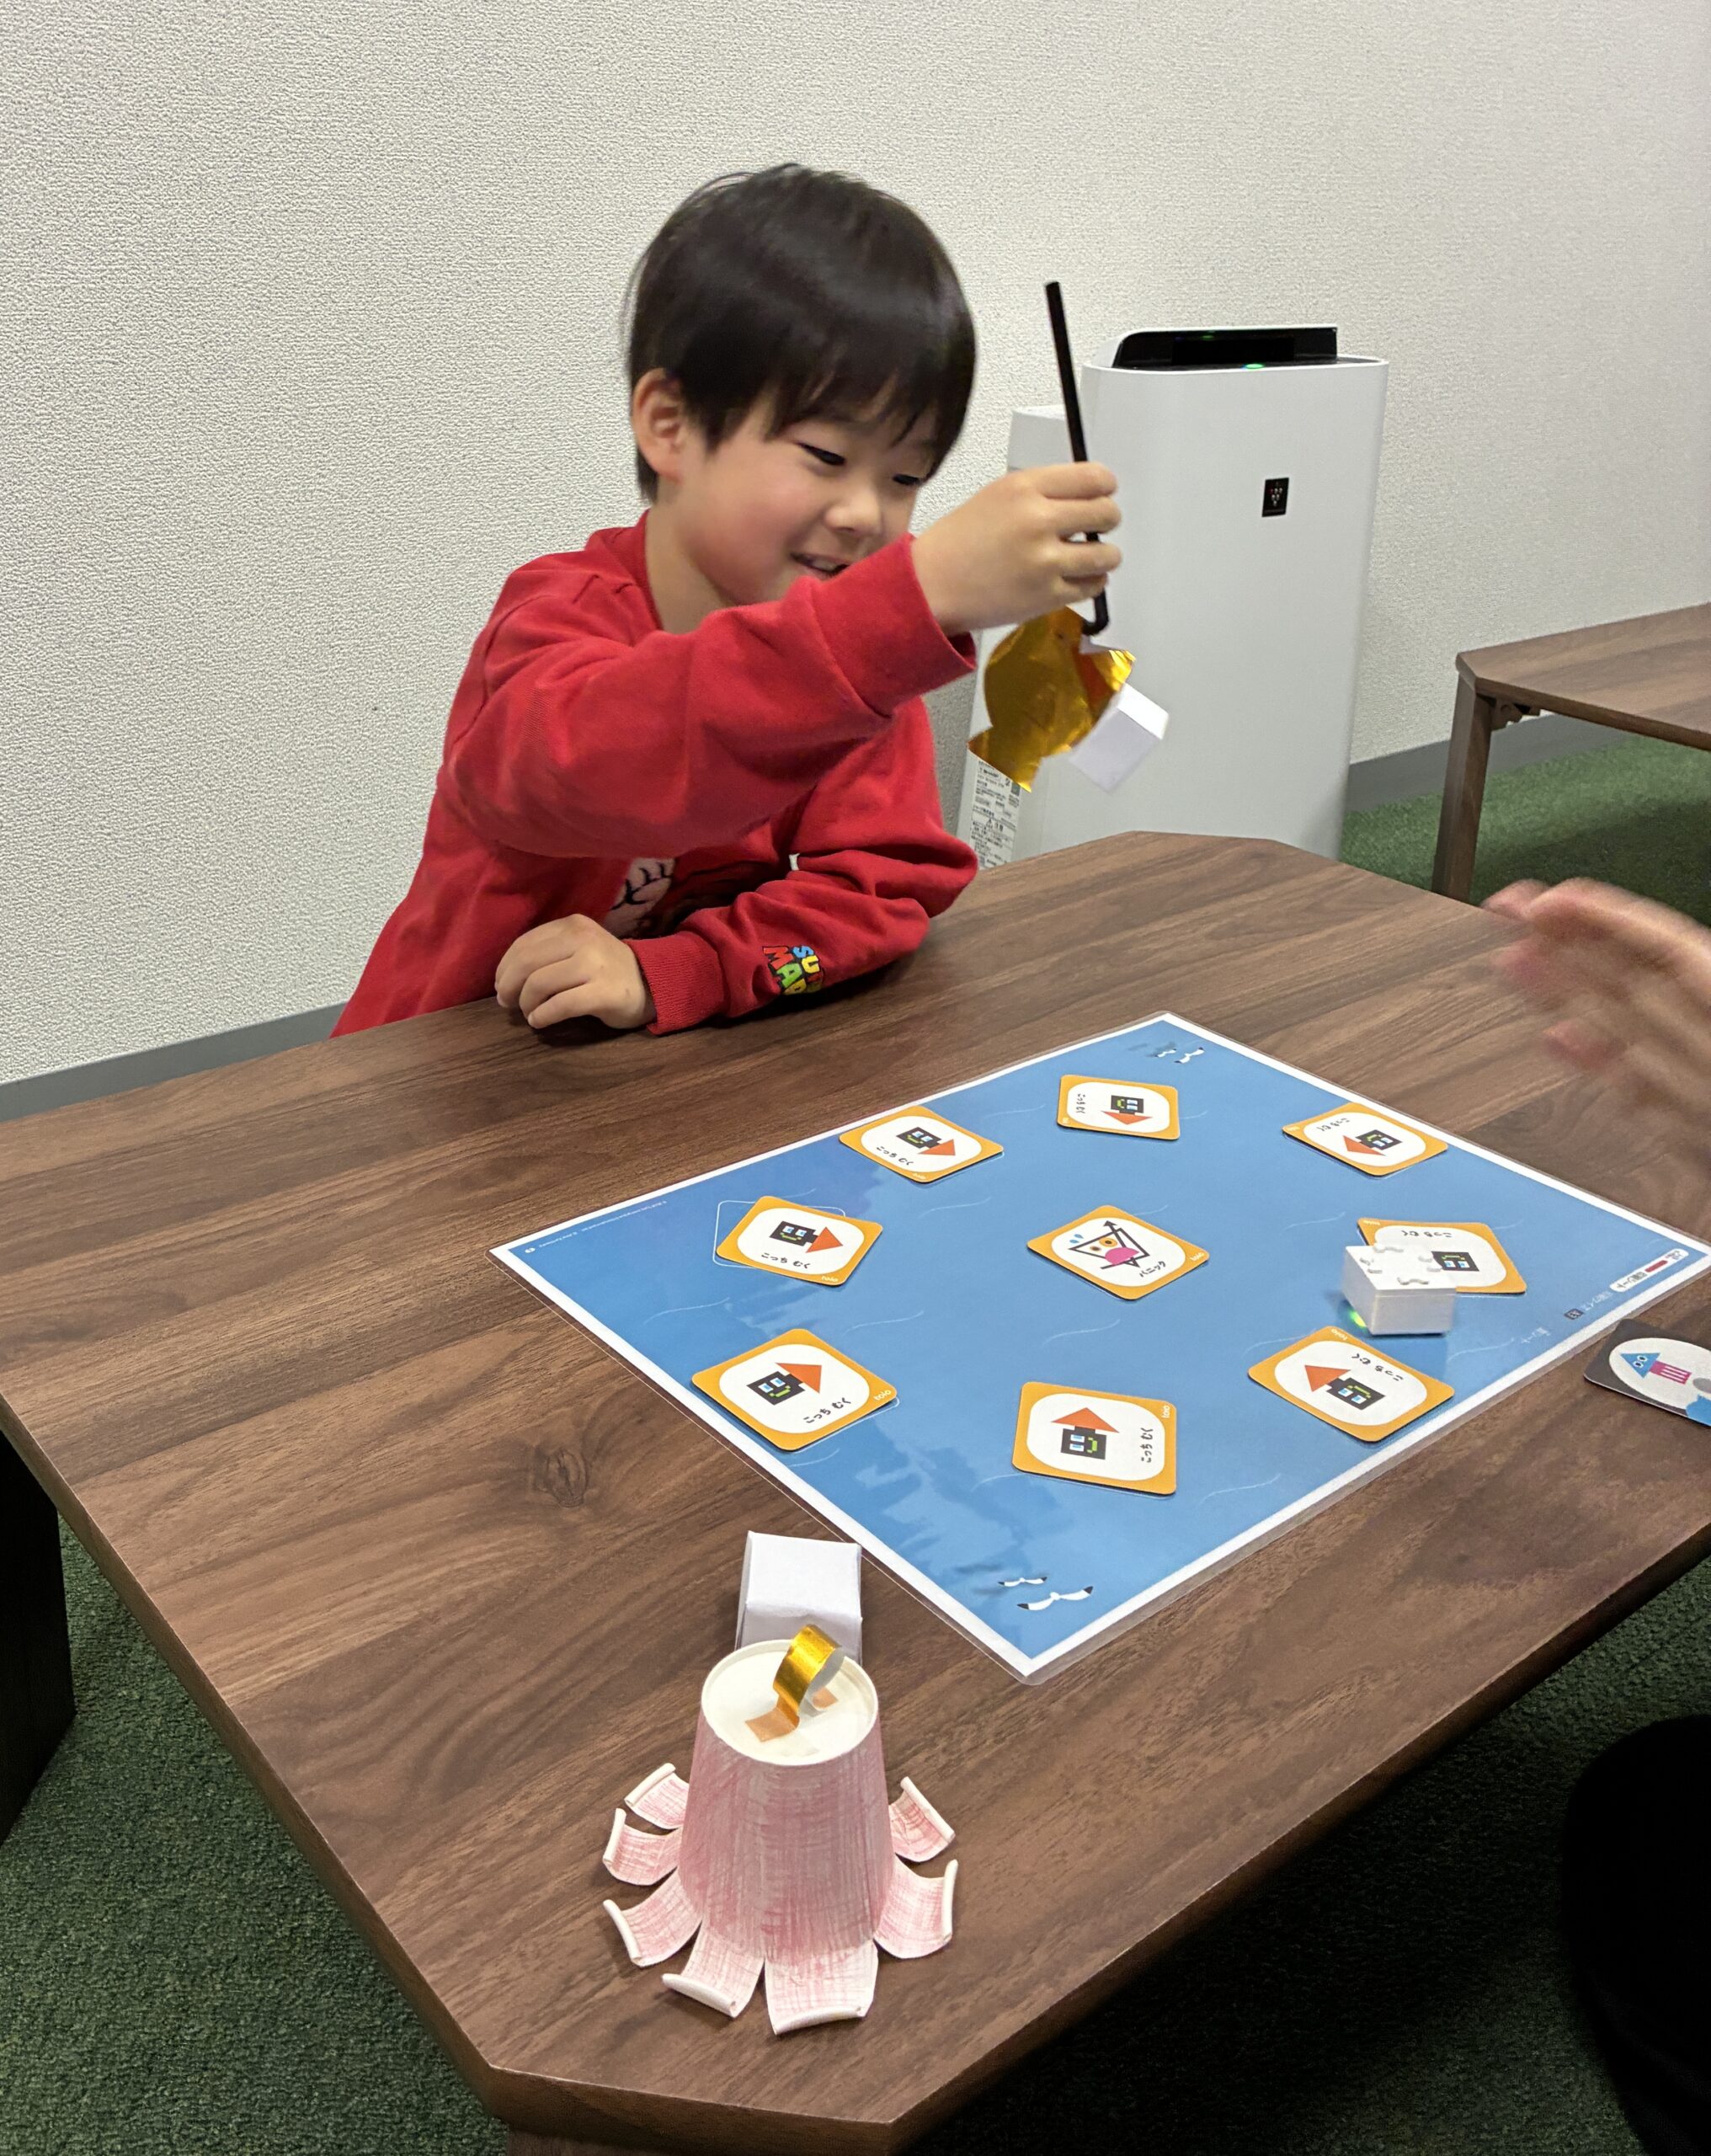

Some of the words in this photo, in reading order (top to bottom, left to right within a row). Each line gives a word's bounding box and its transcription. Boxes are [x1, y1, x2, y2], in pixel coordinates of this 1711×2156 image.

[876, 1146, 898, 1159] こっち
[760, 1252, 788, 1263] こっち
[792, 1260, 811, 1269] むく
[1351, 1353, 1372, 1365] むく
[1374, 1365, 1405, 1381] こっち
[873, 1390, 892, 1401] toio
[802, 1407, 832, 1423] こっち
[831, 1397, 852, 1409] むく
[1140, 1428, 1154, 1440] むく
[1139, 1444, 1154, 1463] こっち
